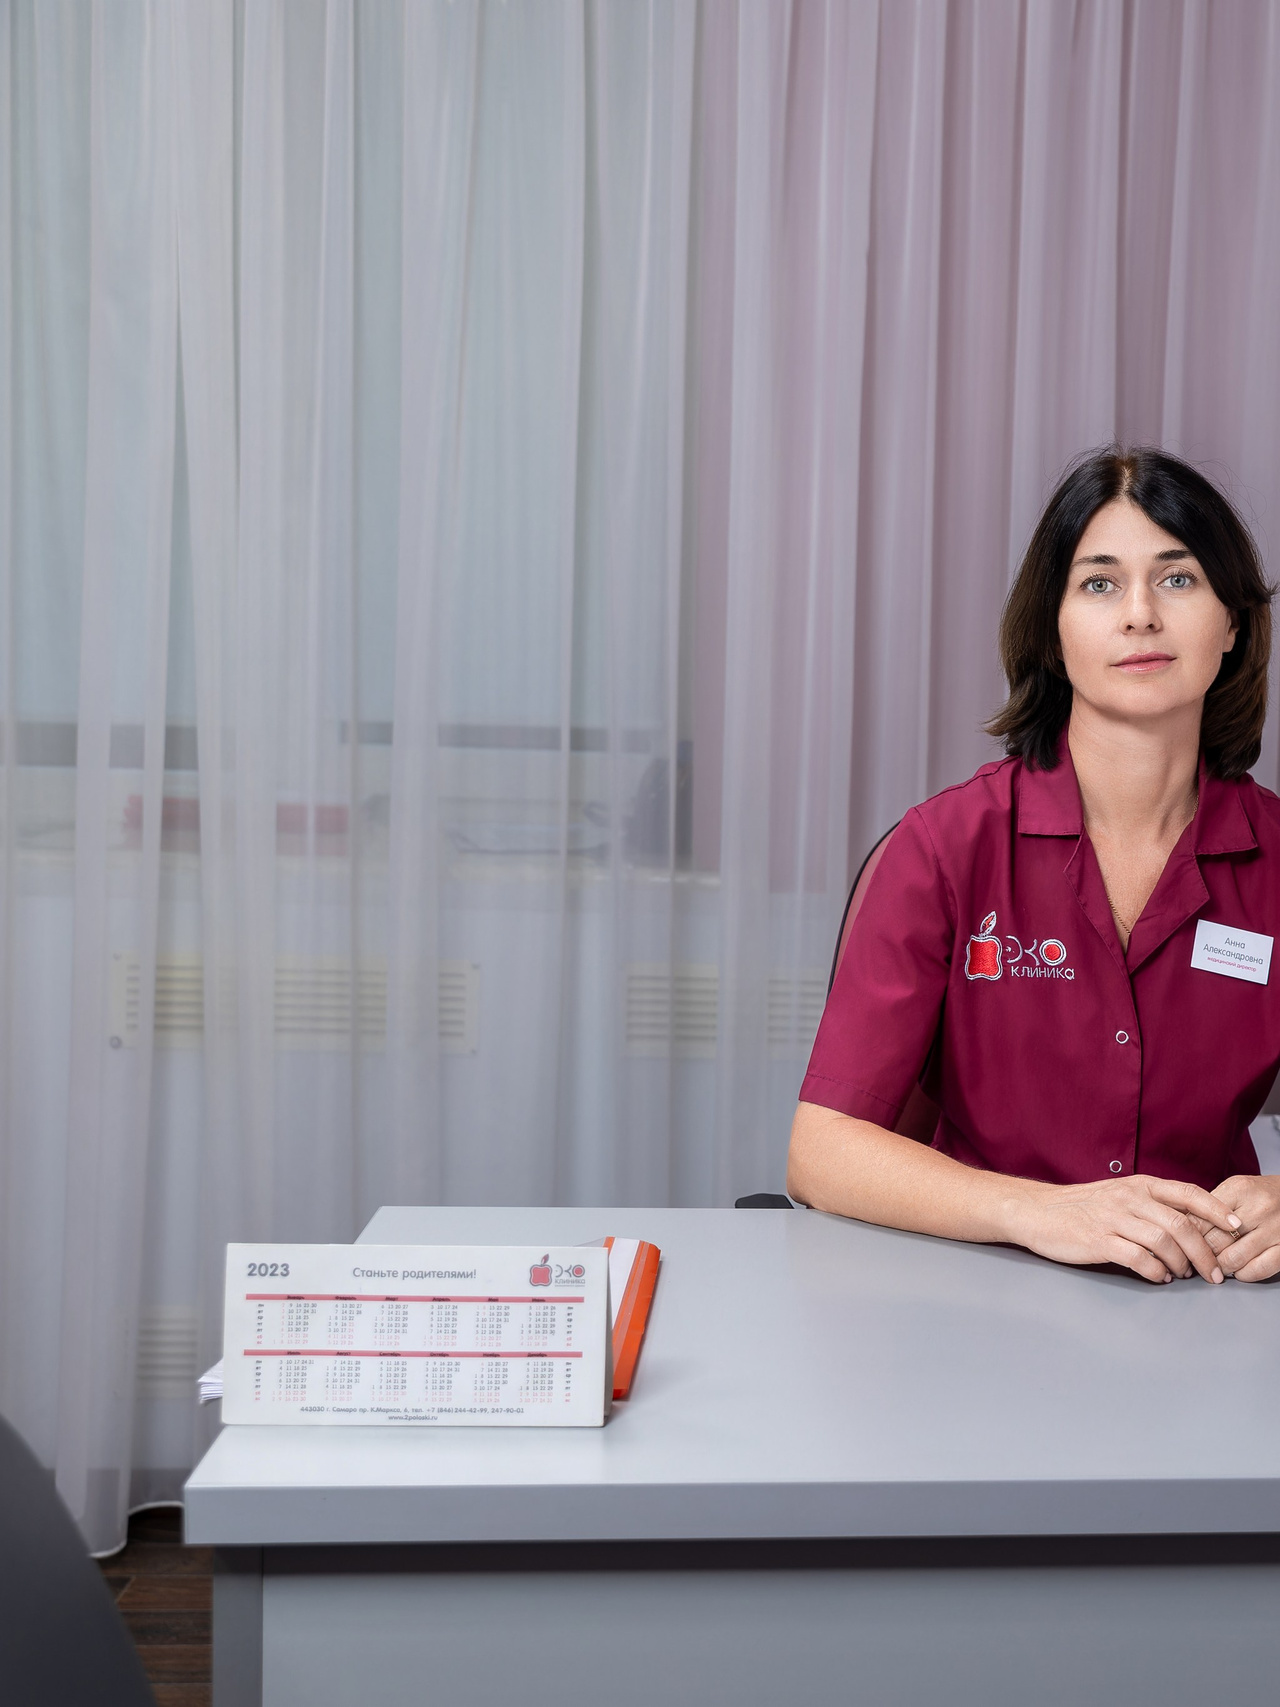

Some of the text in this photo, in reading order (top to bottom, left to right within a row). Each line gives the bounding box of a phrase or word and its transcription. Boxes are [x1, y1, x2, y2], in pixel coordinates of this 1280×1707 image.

[1224, 937, 1245, 949] Анна
[1203, 943, 1264, 965] Александровна
[1207, 956, 1257, 972] медицинский директор
[247, 1263, 290, 1277] 2023
[353, 1267, 477, 1280] Станьте родителями!
